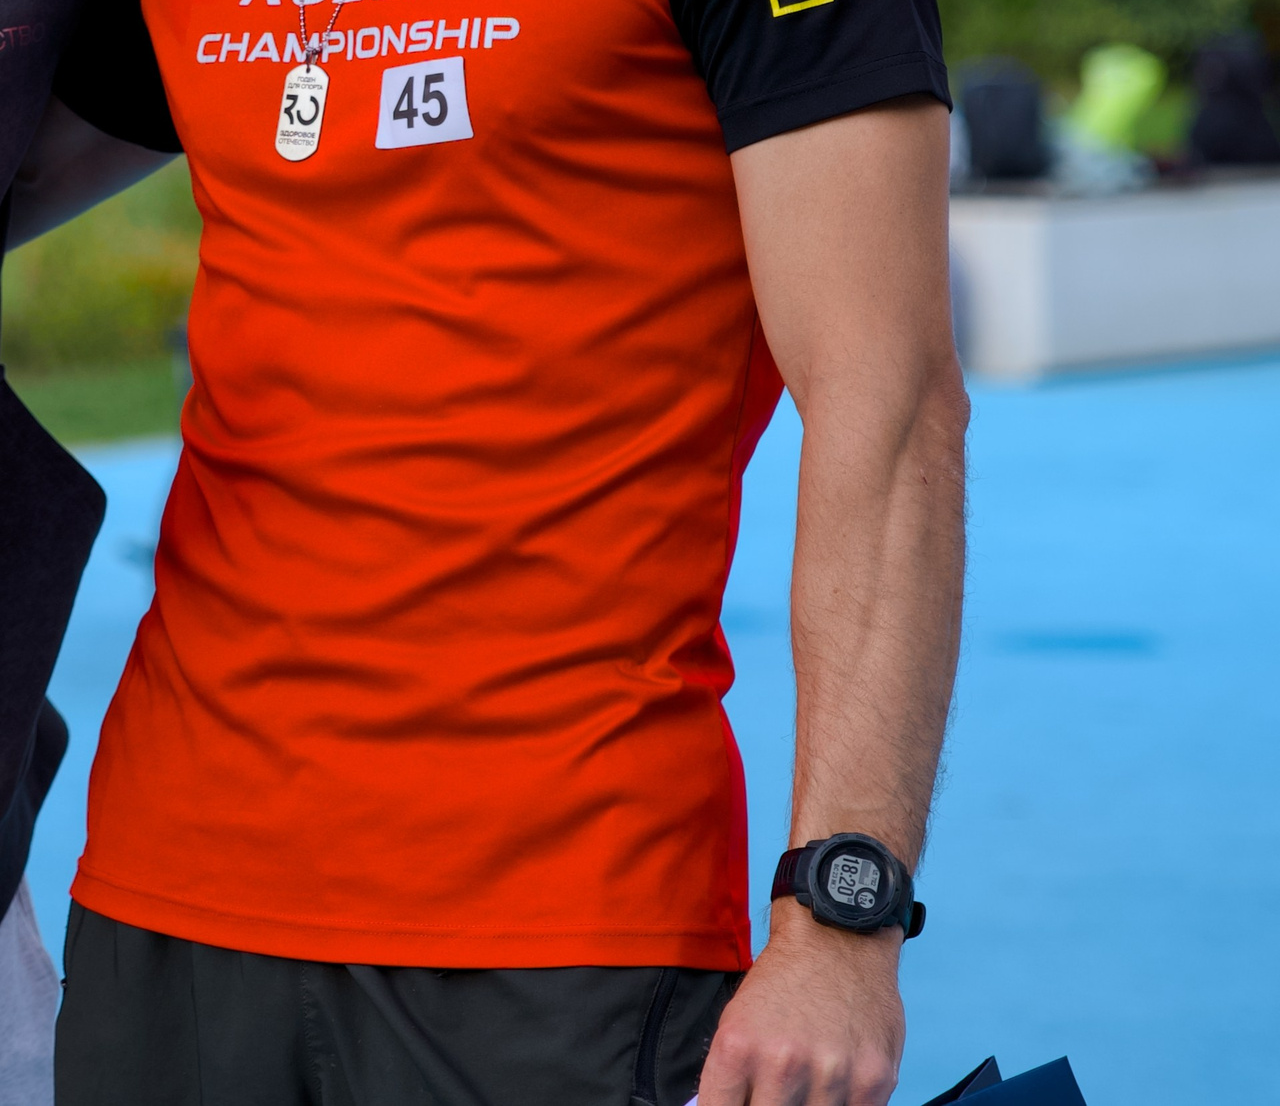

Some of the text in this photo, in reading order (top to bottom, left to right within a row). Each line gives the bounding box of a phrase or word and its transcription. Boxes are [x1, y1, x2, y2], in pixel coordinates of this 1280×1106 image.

[196, 17, 520, 64] CHAMPIONSHIP
[392, 72, 448, 129] 45
[278, 138, 315, 146] ОТЕЧЕСТВО
[279, 130, 316, 139] ЗДОРОВОЕ
[837, 858, 860, 897] 18:20
